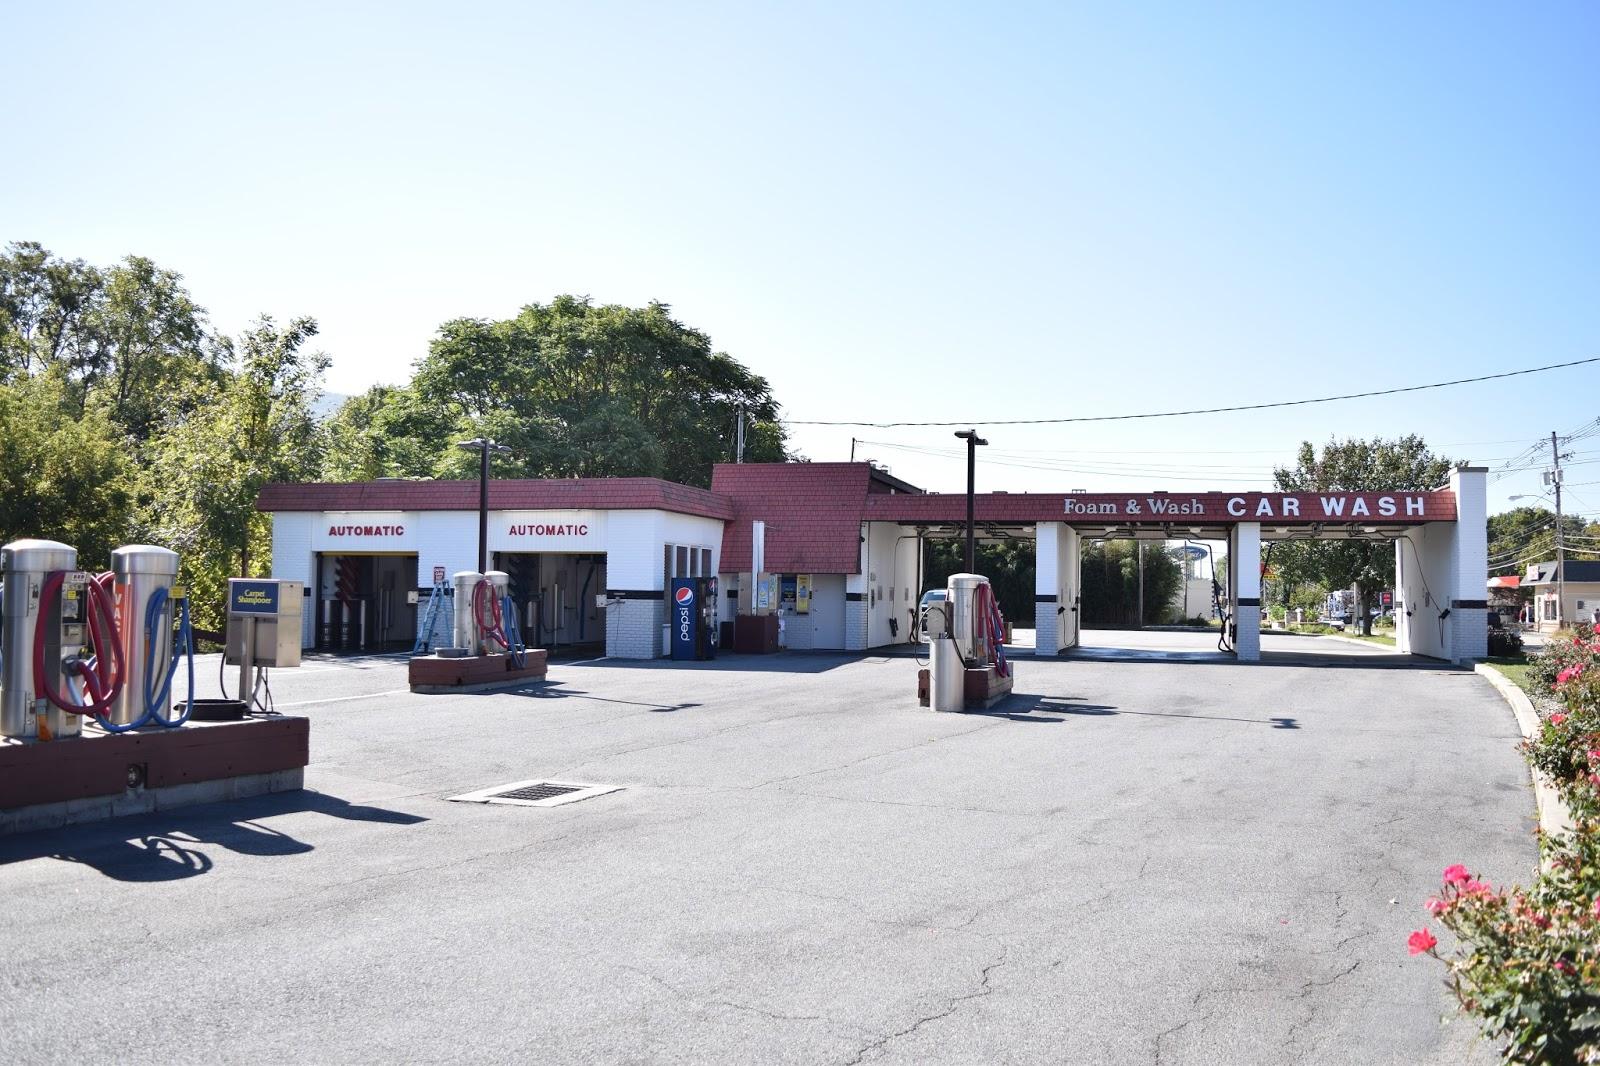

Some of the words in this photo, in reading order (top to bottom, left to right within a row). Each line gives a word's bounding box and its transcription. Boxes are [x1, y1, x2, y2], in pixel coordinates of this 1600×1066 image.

[1064, 498, 1117, 514] Foam
[1126, 499, 1141, 514] &
[1147, 499, 1205, 515] Wash
[1227, 497, 1300, 517] CAR
[1320, 497, 1425, 516] WASH
[329, 526, 404, 536] AUTOMATIC
[509, 525, 588, 536] AUTOMATIC
[244, 589, 265, 598] Carpet
[238, 596, 272, 605] Shampooer
[679, 607, 690, 641] pepsi
